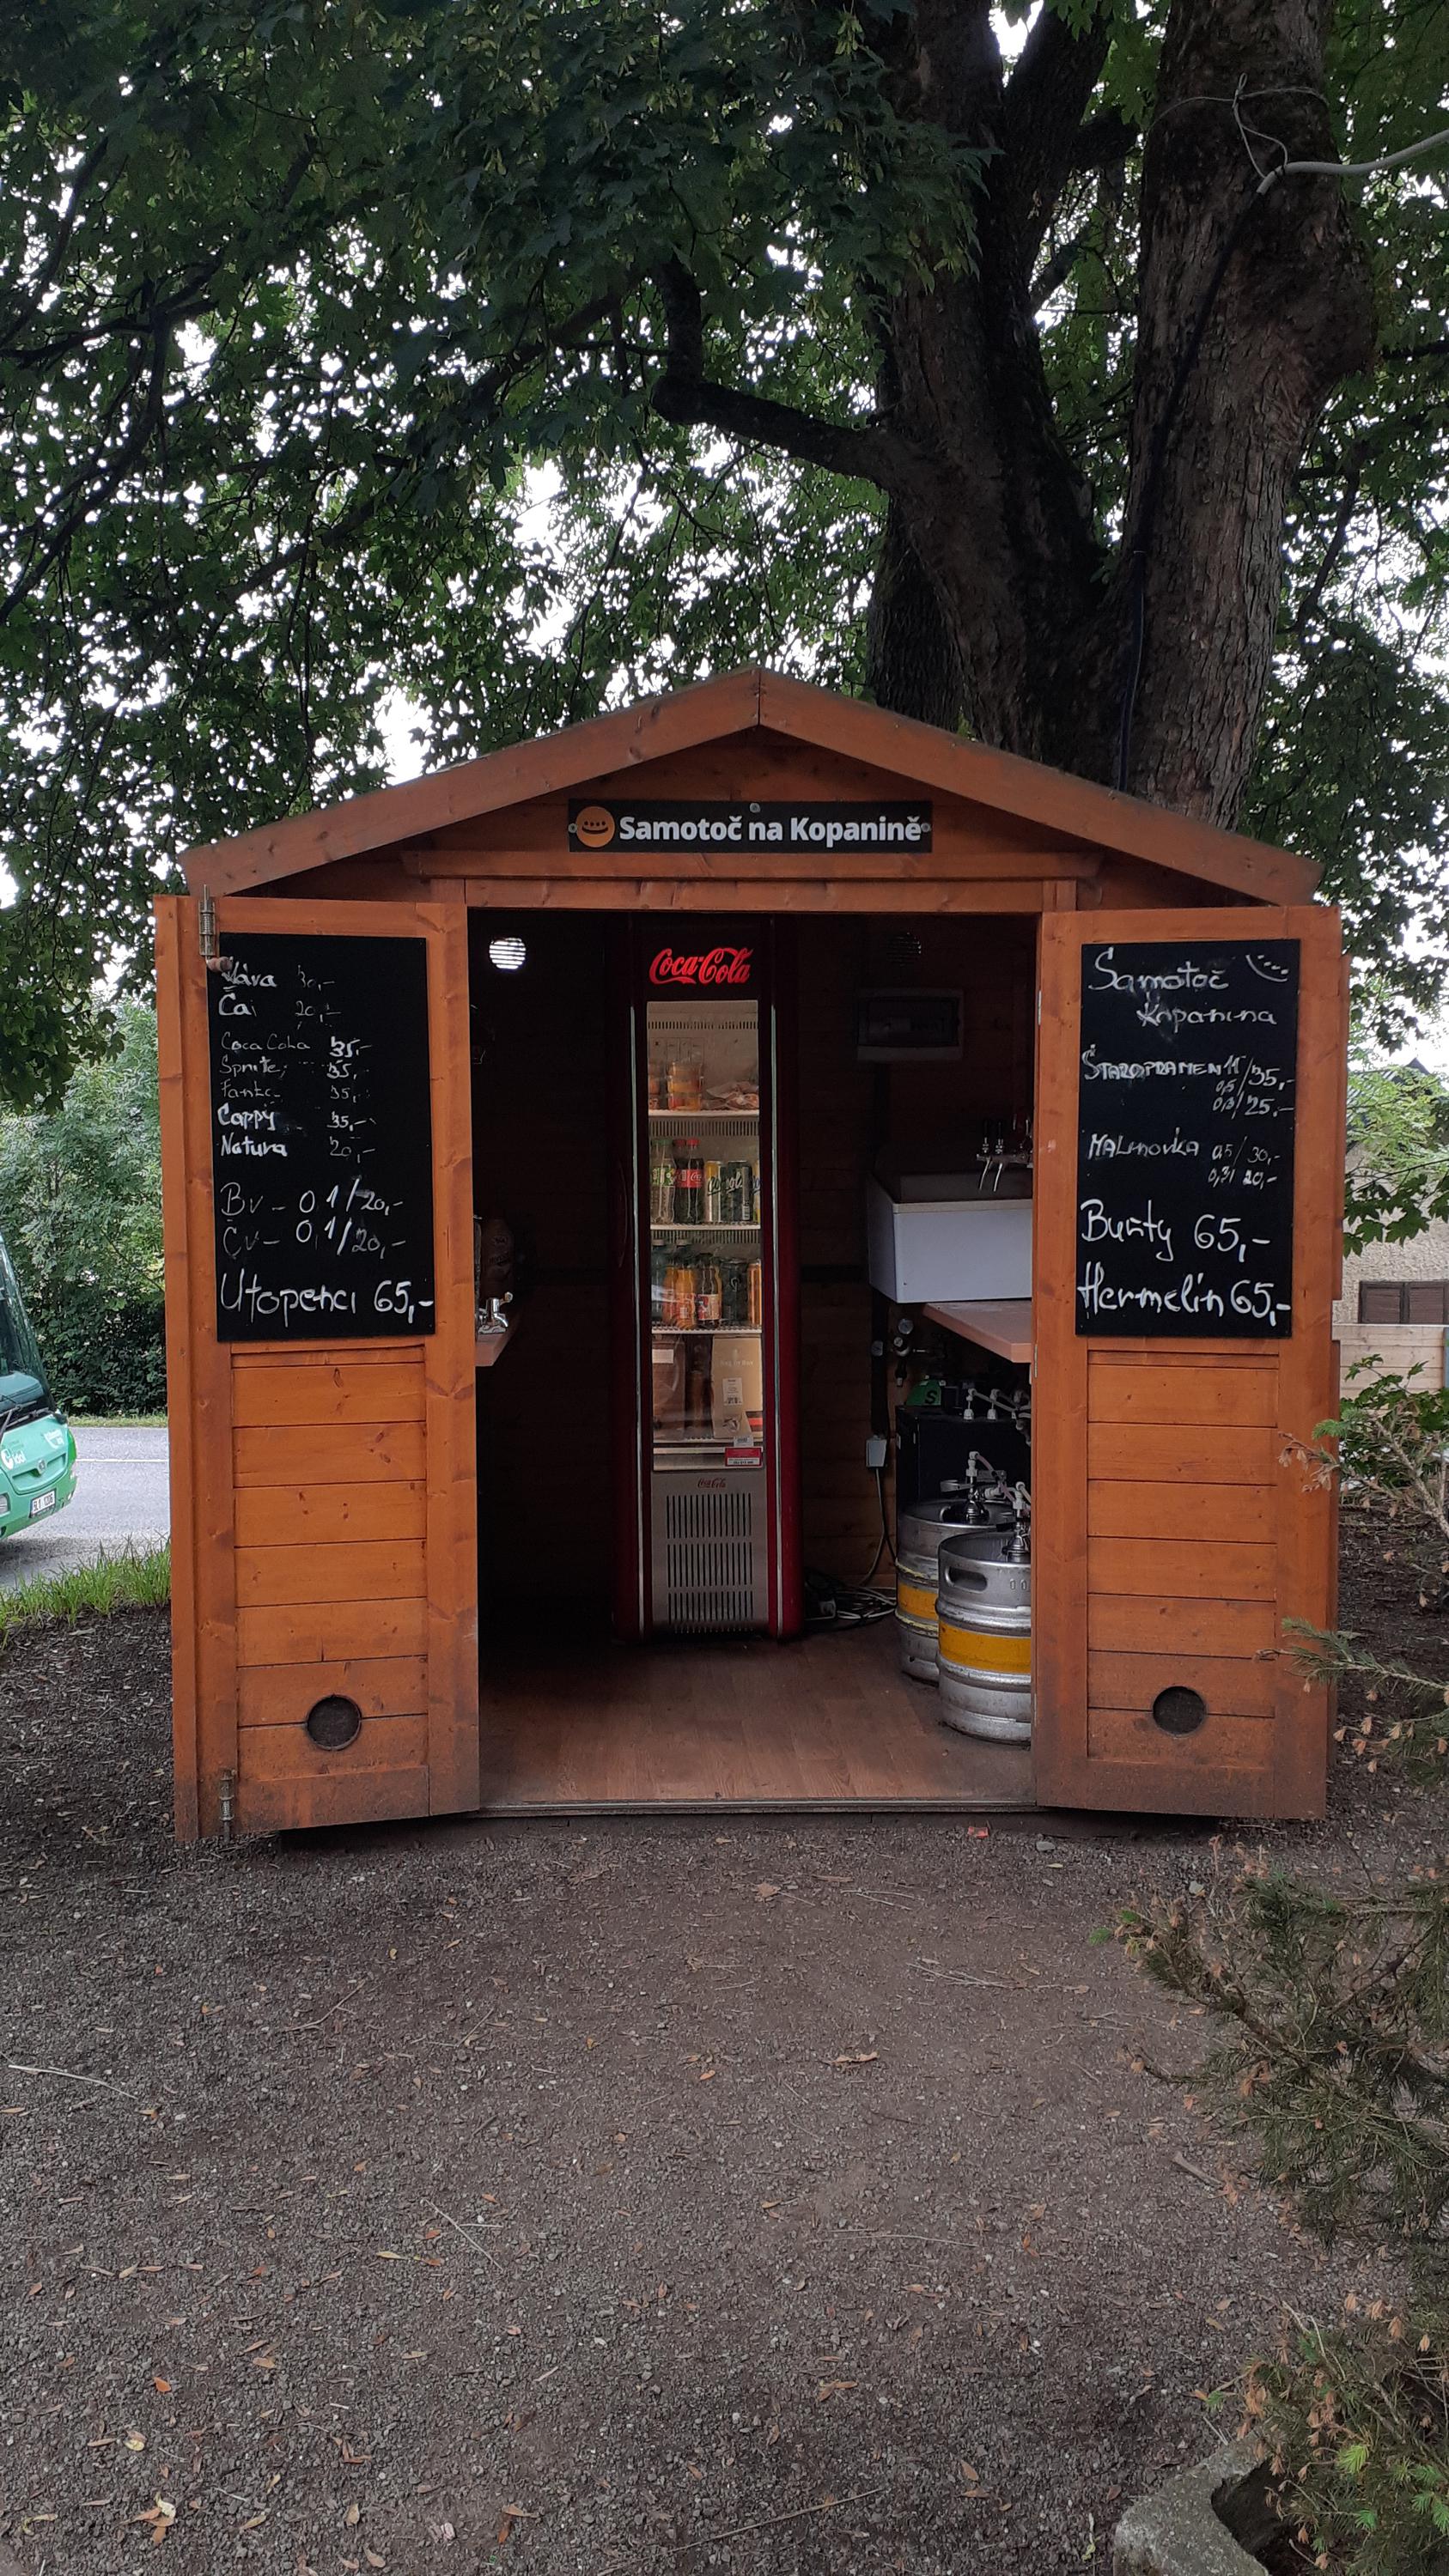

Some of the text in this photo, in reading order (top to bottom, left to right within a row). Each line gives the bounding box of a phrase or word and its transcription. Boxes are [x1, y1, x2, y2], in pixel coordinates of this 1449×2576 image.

[619, 816, 922, 848] Samotoč na Kopanině
[649, 947, 754, 984] Coca-Cola
[1087, 947, 1230, 993] Samotoč
[1194, 1213, 1271, 1263] 65,-
[373, 1279, 435, 1324] 65,-
[1230, 1279, 1292, 1327] 65,-
